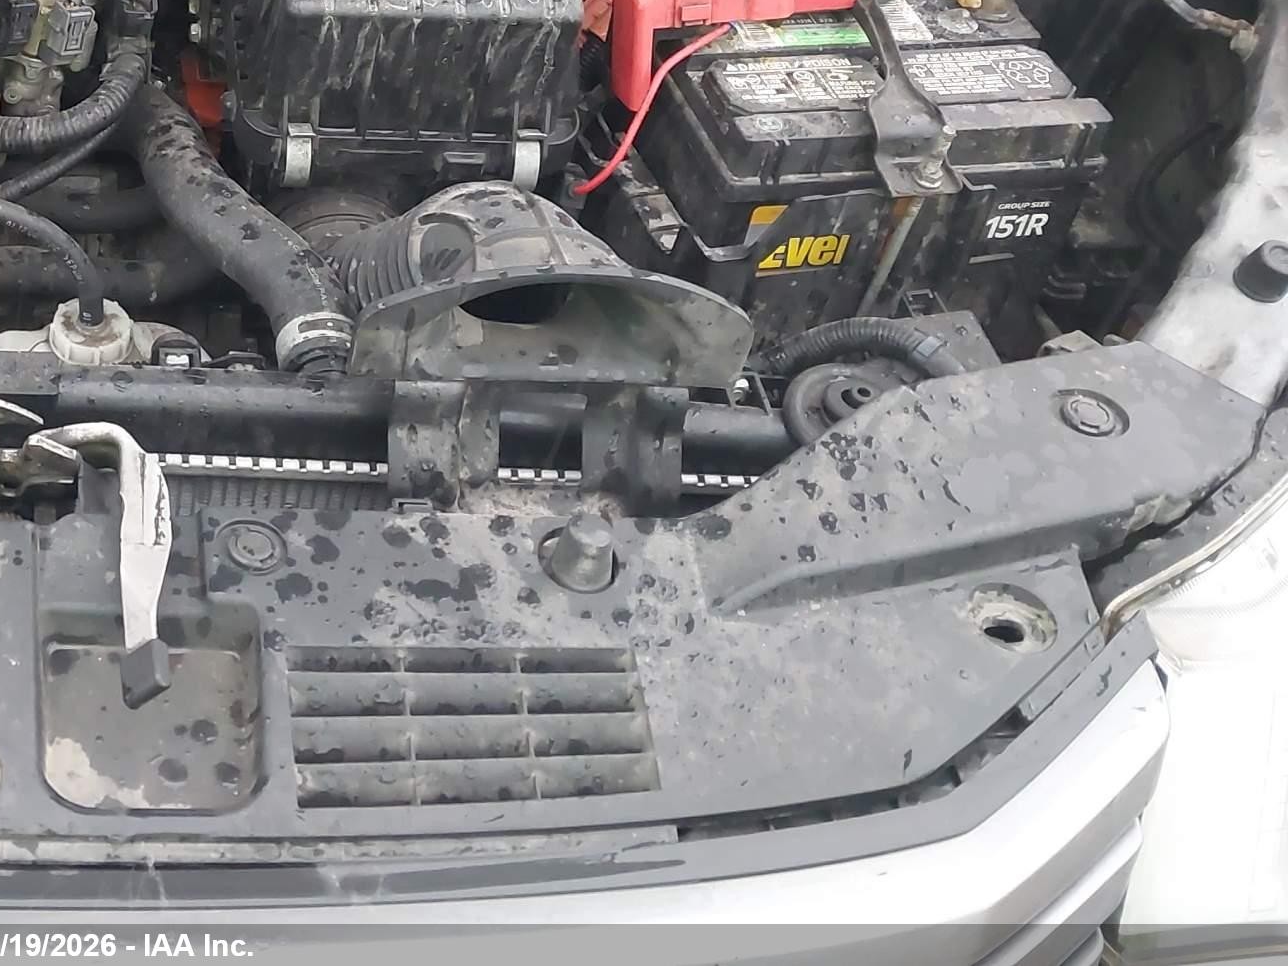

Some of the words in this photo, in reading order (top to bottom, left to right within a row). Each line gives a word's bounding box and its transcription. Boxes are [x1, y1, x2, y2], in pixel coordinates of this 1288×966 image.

[736, 61, 792, 72] DANGER
[802, 57, 852, 69] POISON
[985, 213, 1050, 239] 151R
